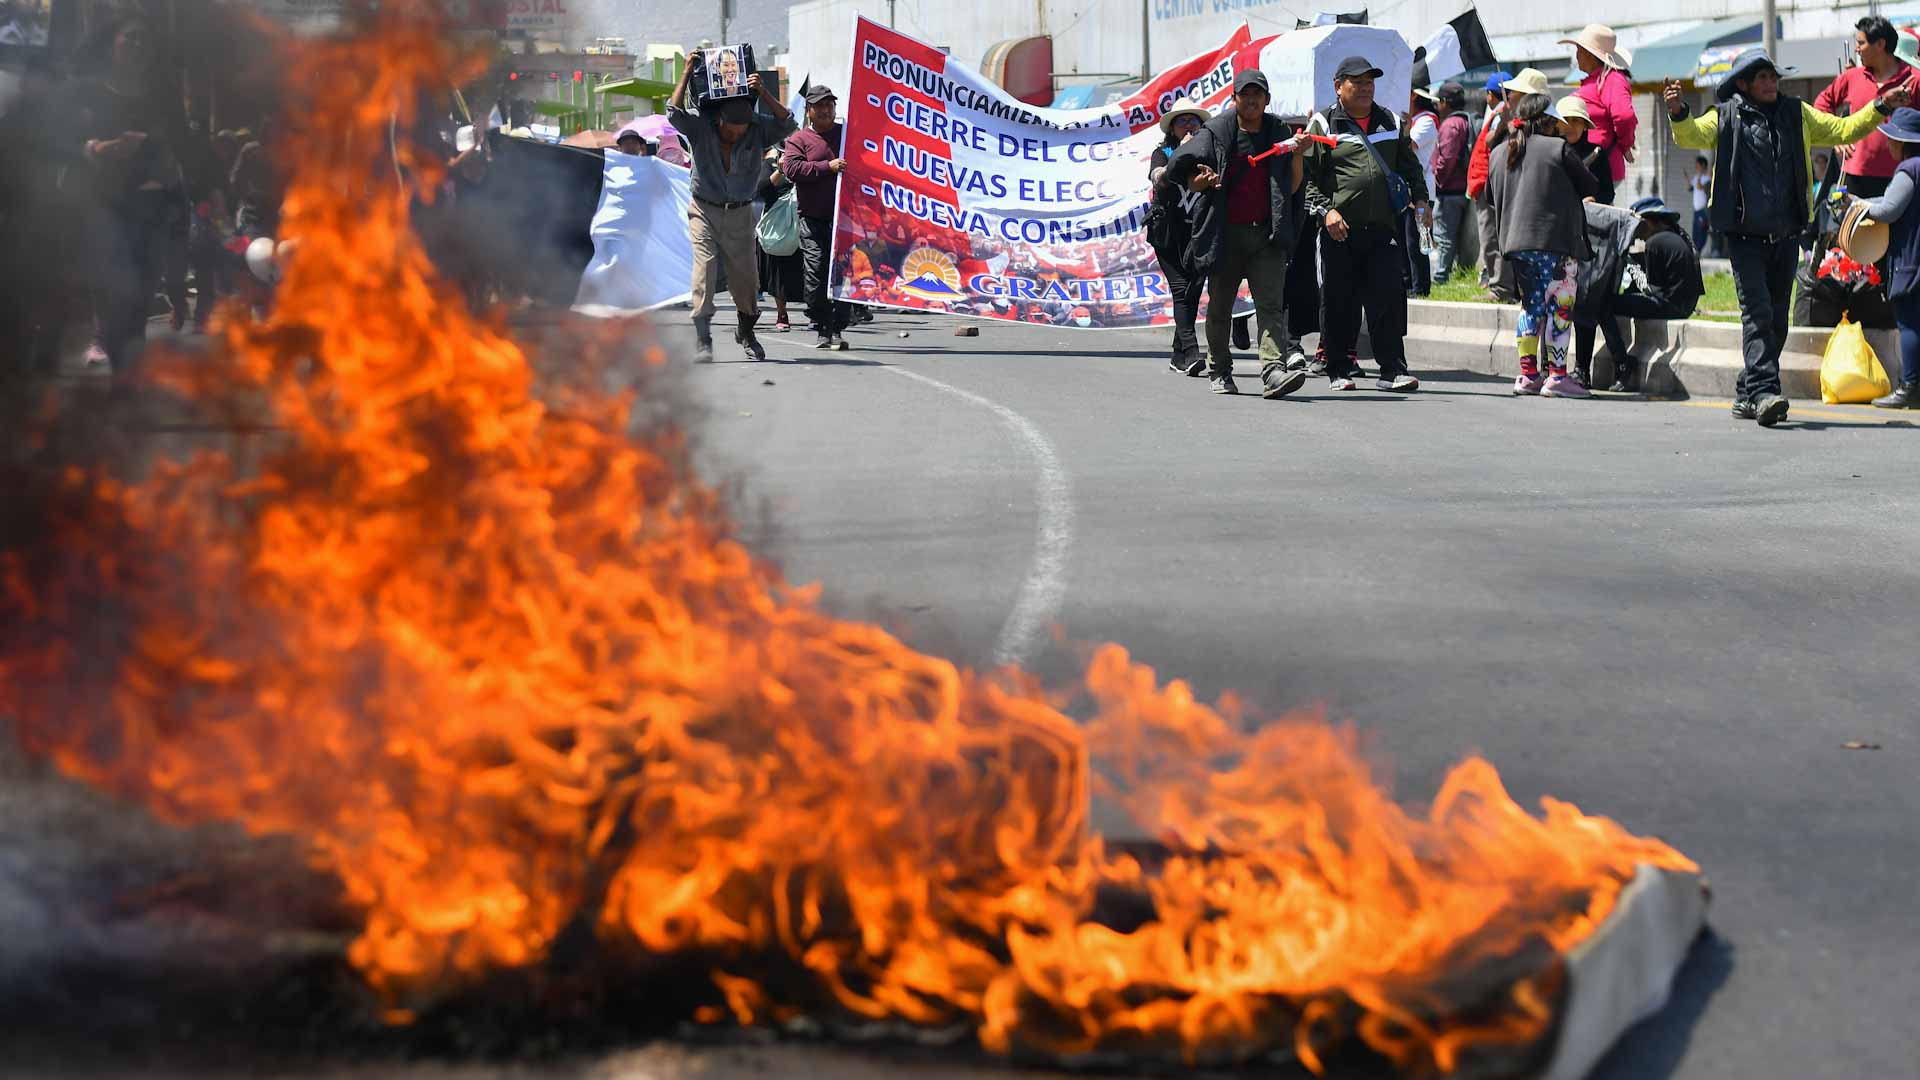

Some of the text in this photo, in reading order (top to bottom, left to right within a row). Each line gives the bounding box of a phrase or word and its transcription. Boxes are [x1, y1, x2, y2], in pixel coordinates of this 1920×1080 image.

[887, 94, 987, 151] CIERRE
[998, 133, 1057, 163] DEL
[1129, 106, 1152, 124] A.
[885, 138, 1007, 198] NUEVAS
[883, 183, 991, 237] NUEVA
